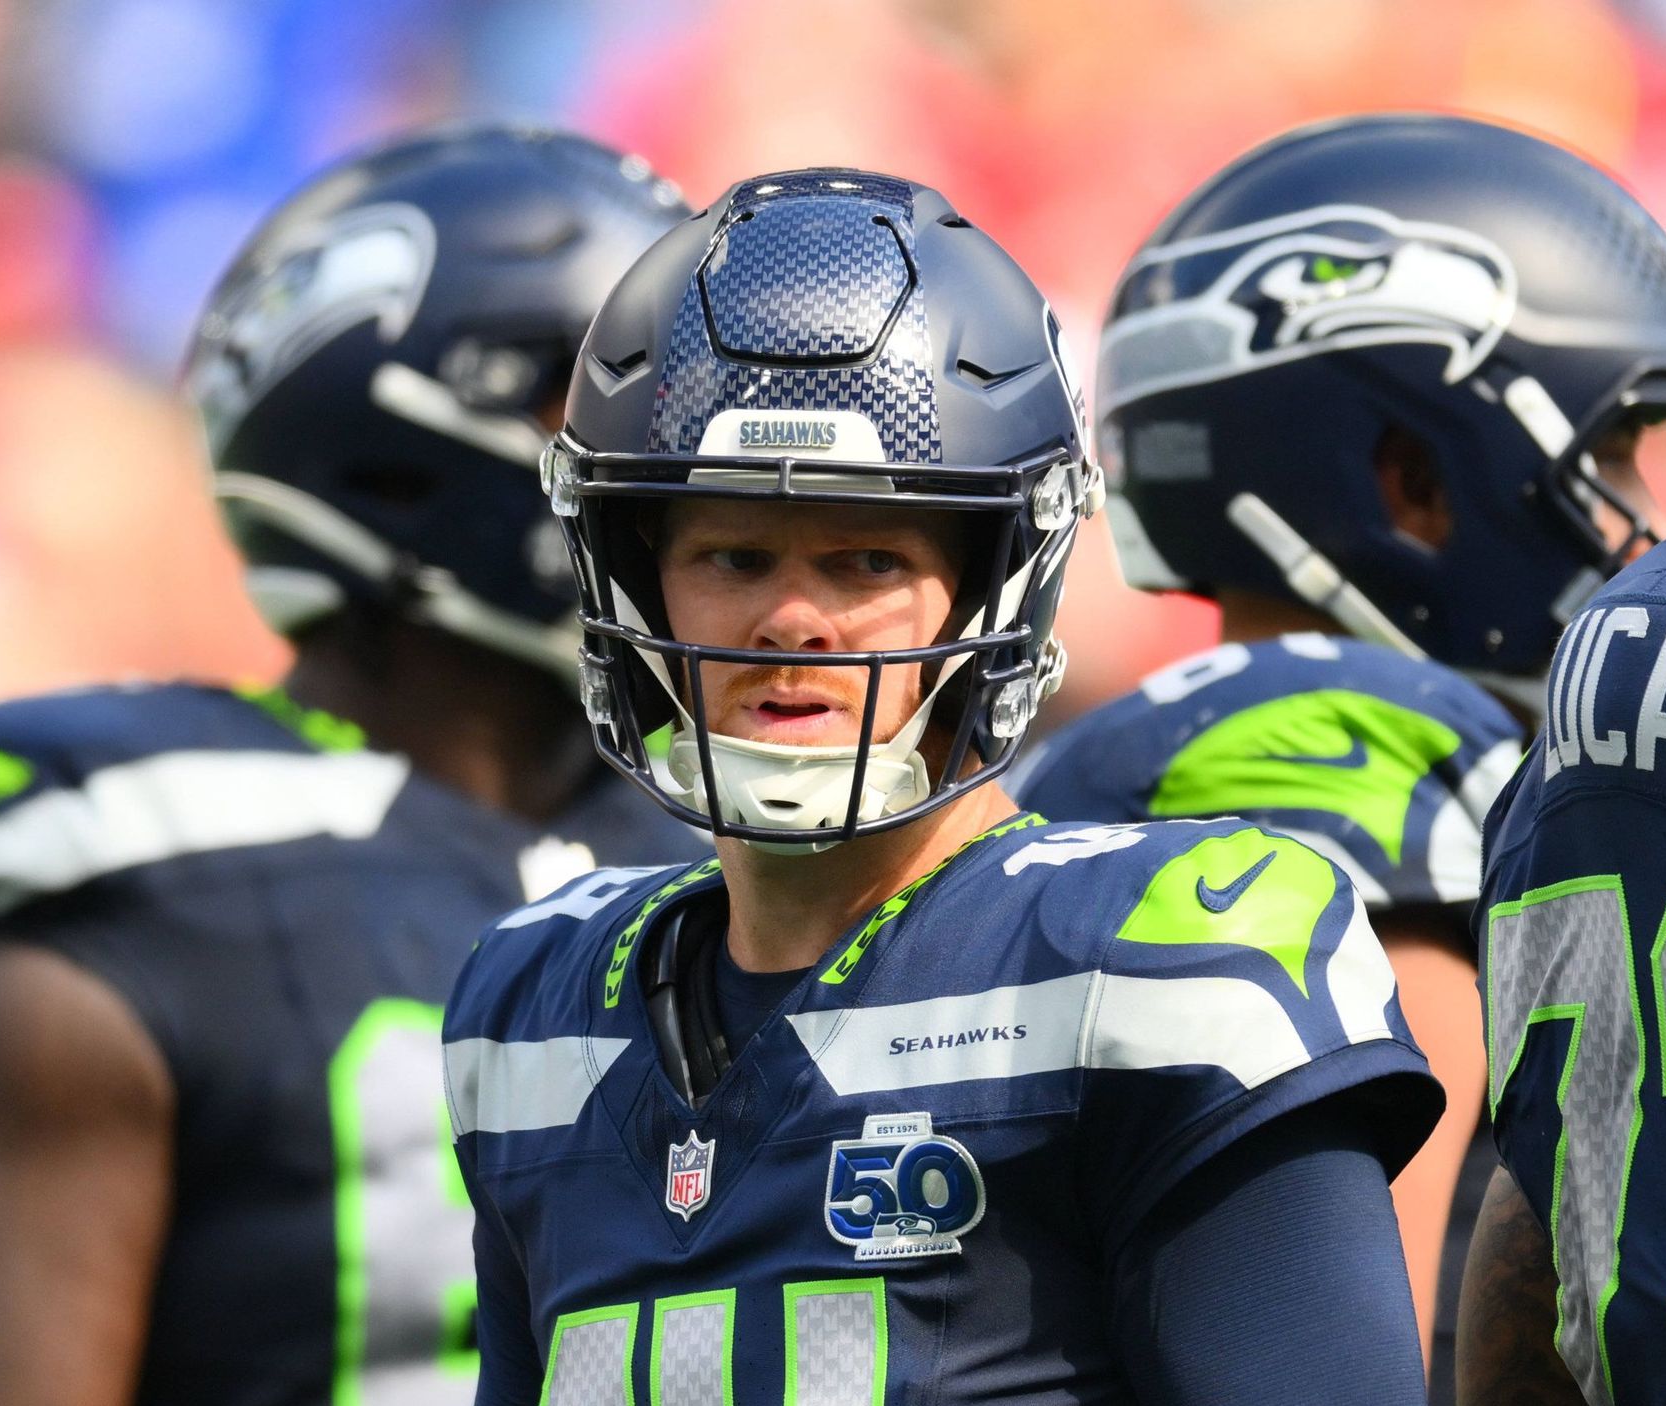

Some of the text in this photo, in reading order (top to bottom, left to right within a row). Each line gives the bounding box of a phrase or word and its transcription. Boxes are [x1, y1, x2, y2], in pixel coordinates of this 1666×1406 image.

[739, 420, 837, 449] SEAHAWKS
[889, 1024, 1027, 1055] SEAHAWKS
[876, 1125, 918, 1135] EST 1976
[673, 1173, 702, 1205] NFL
[830, 1141, 979, 1240] 50
